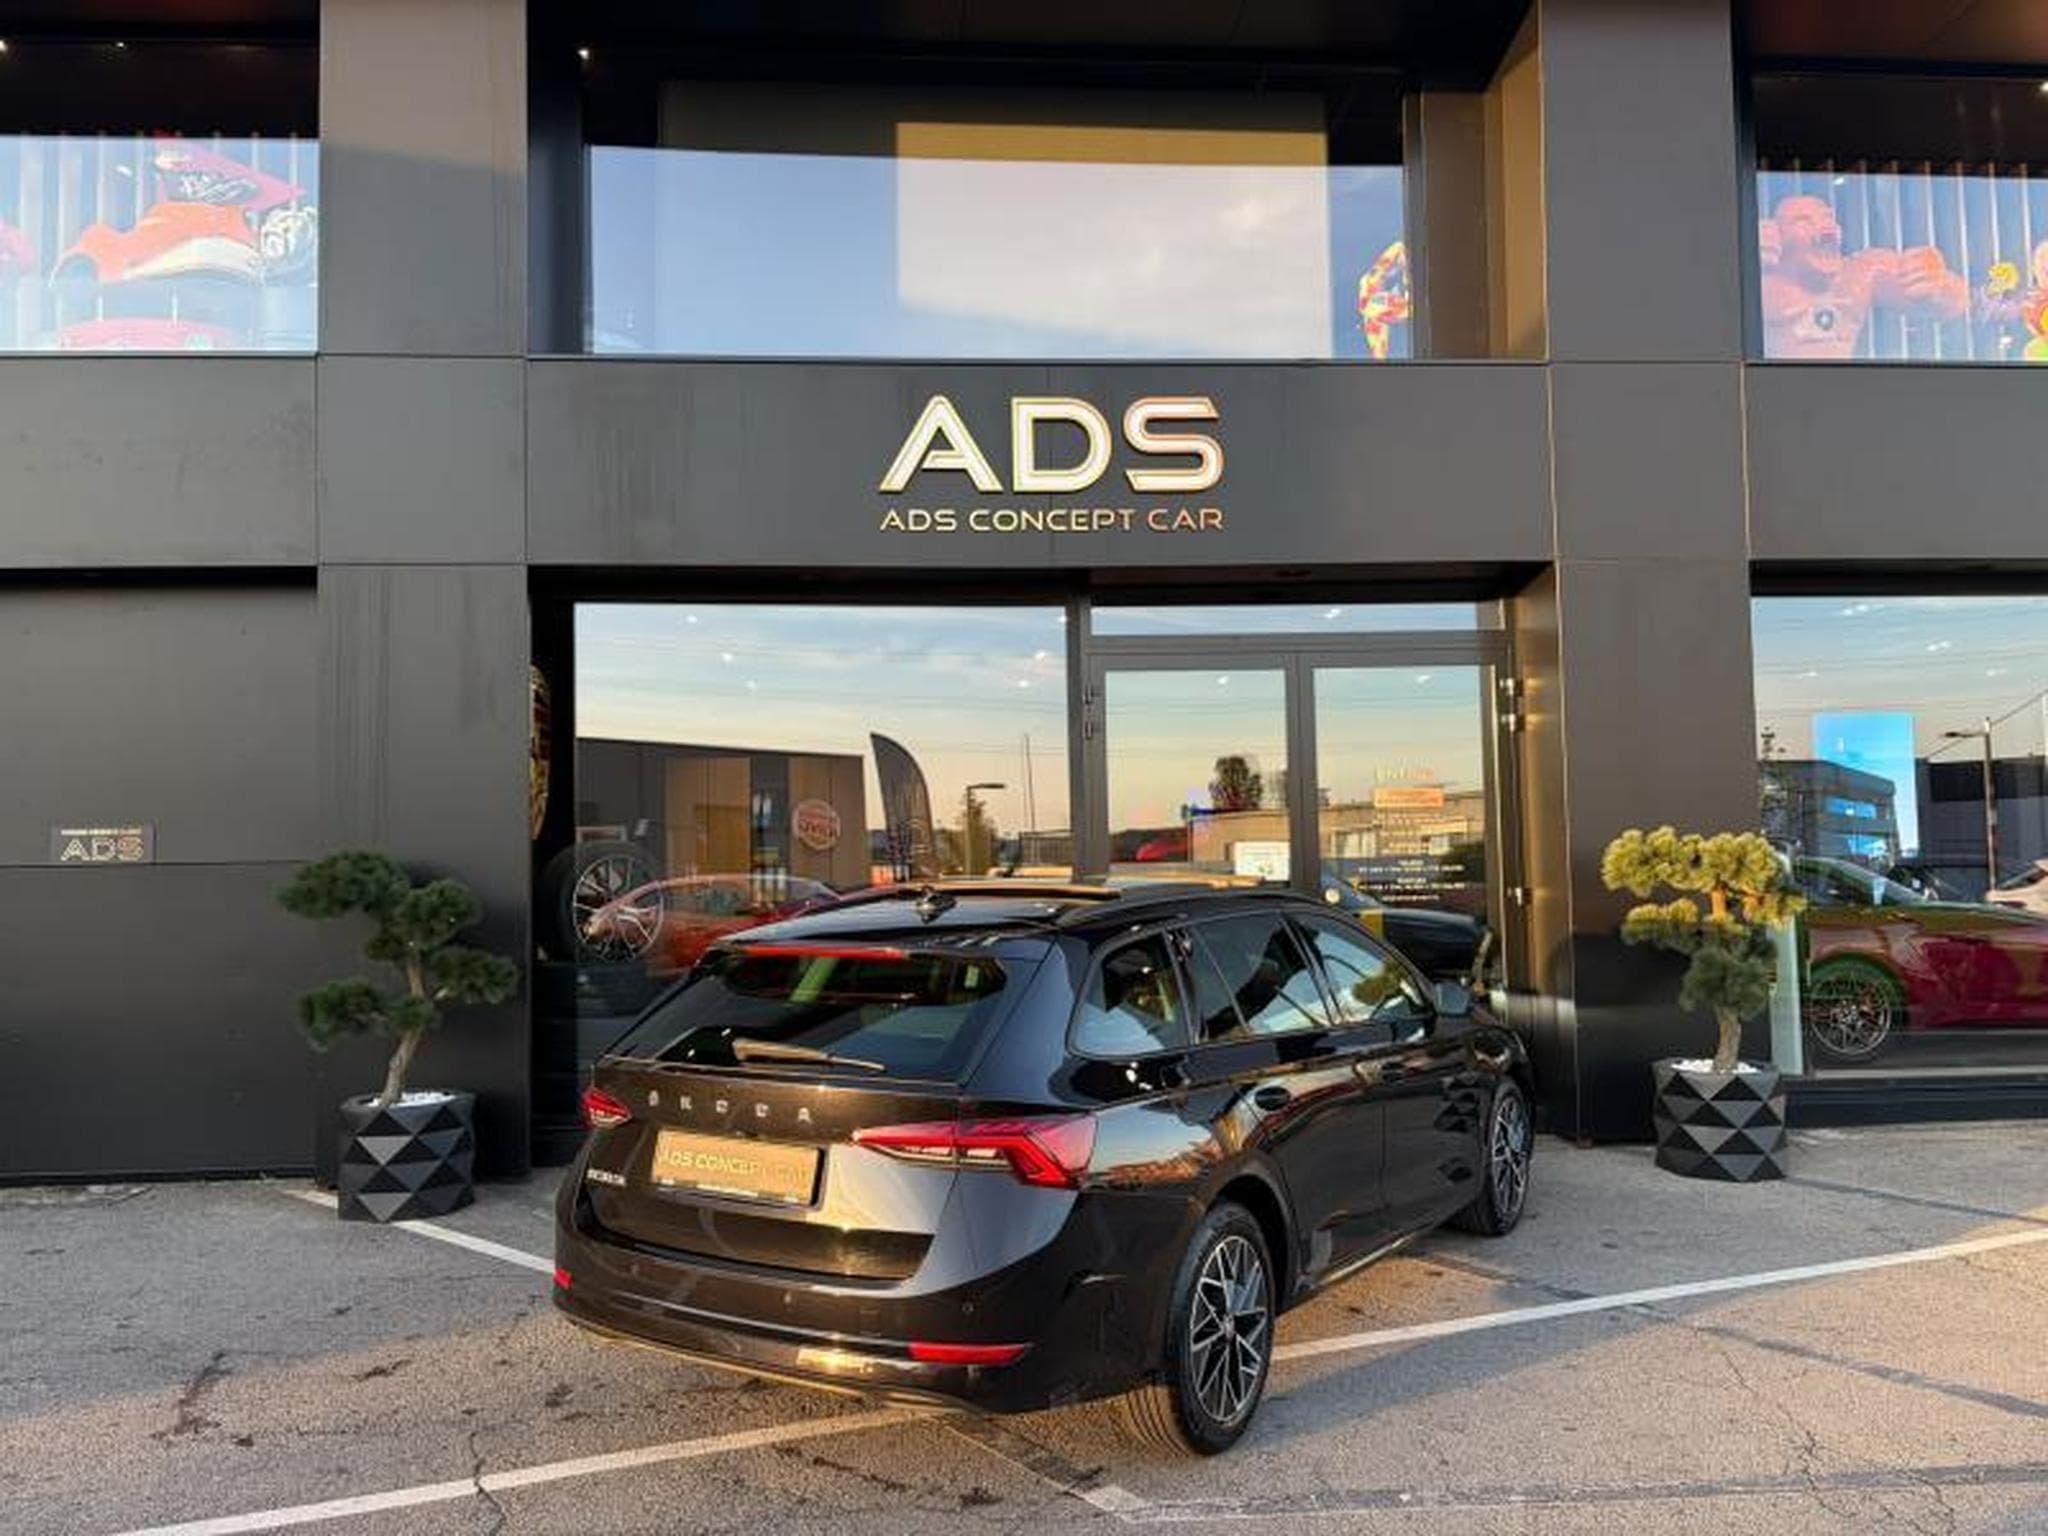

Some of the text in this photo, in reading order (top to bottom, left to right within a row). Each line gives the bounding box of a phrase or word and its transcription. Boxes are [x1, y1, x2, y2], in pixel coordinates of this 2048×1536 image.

[879, 395, 1225, 493] ADS
[879, 509, 1224, 531] ADS CONCEPT CAR
[61, 837, 144, 861] ADS
